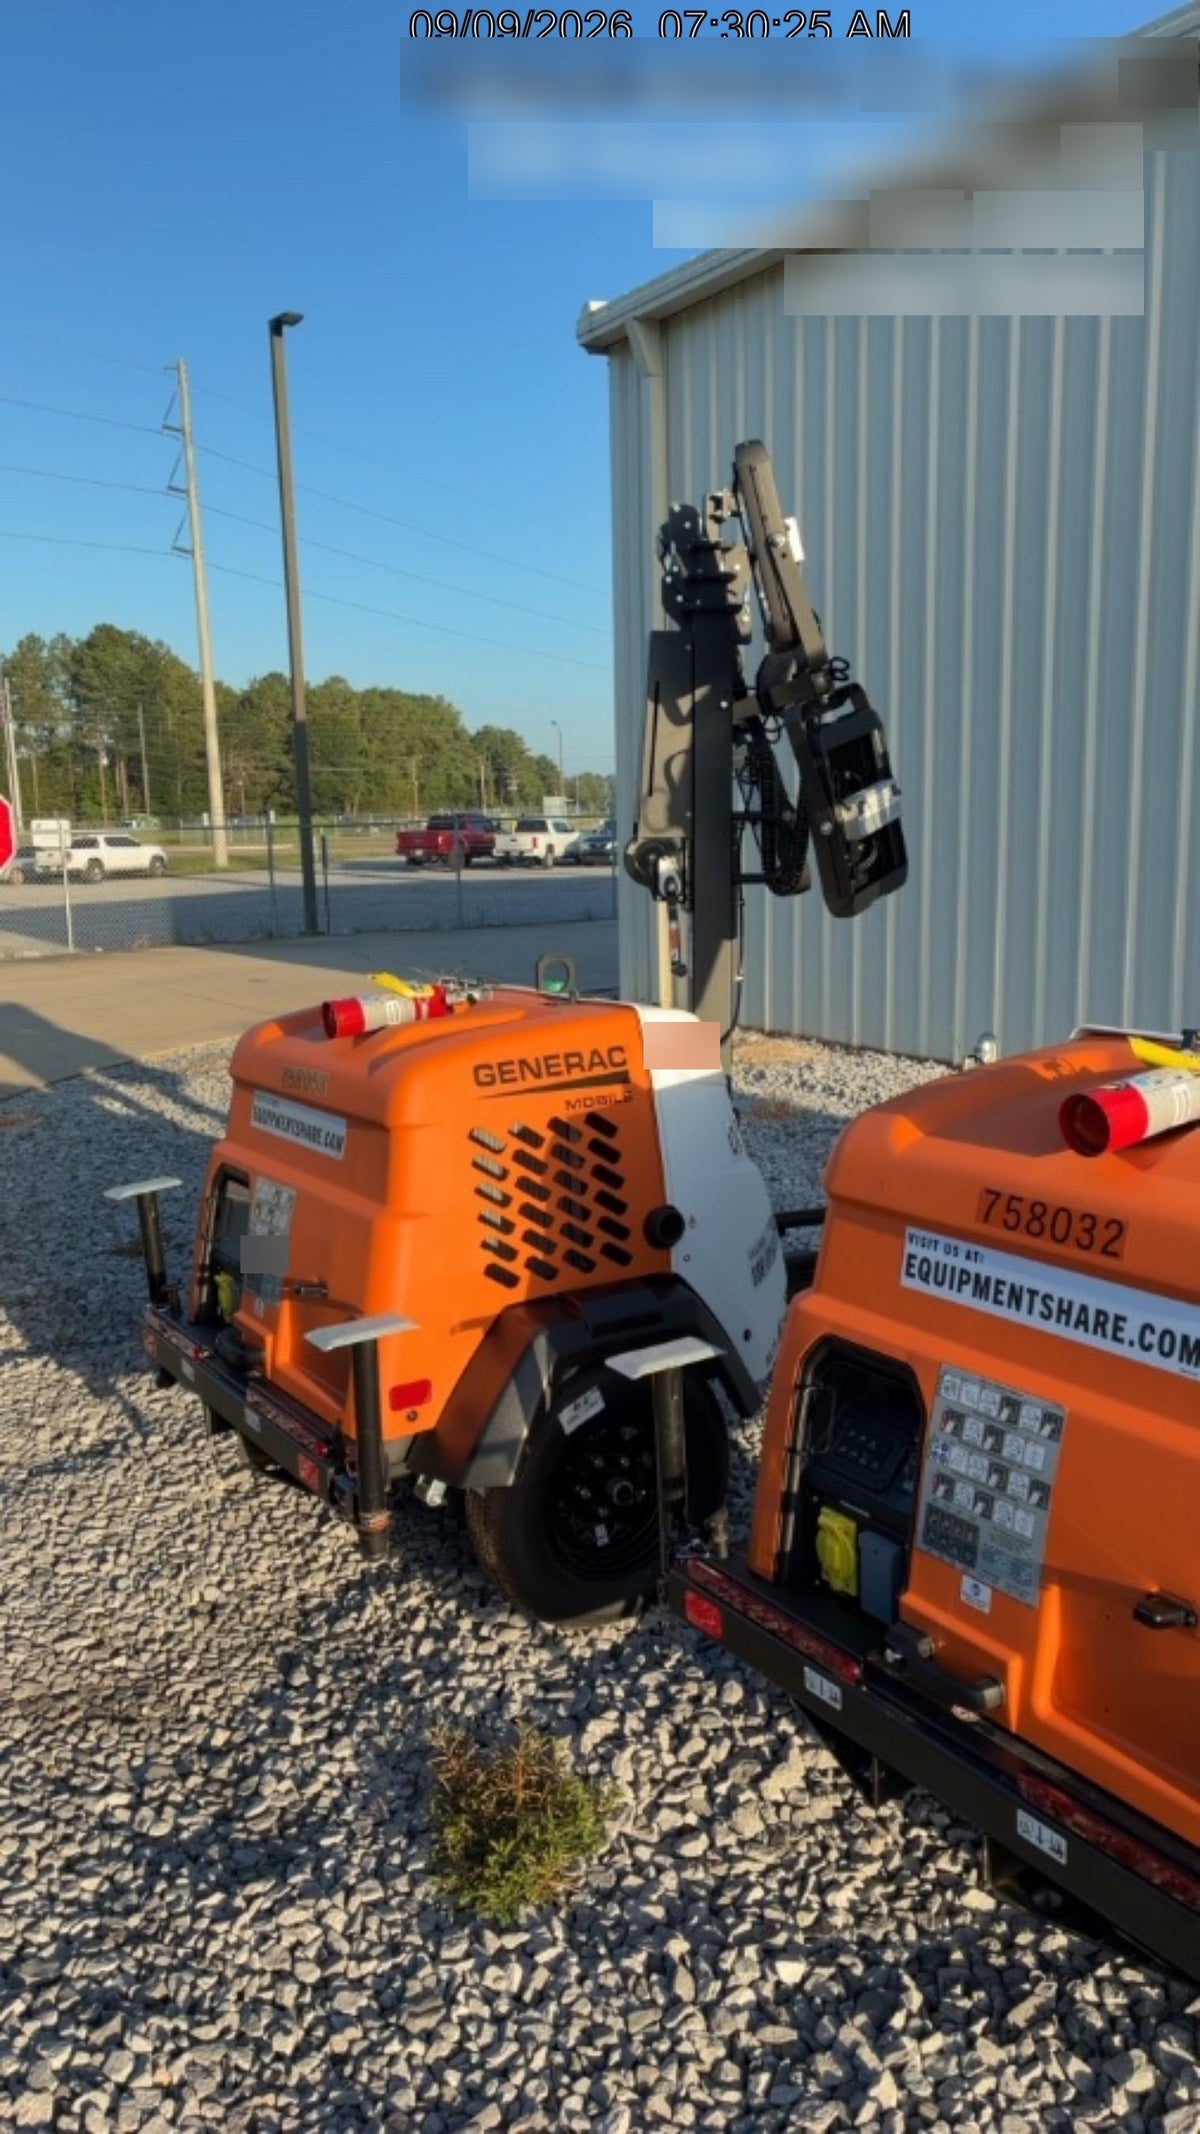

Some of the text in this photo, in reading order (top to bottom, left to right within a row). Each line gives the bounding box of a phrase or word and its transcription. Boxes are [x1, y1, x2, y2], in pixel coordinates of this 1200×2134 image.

[473, 1045, 627, 1087] GENERAC
[564, 1090, 633, 1111] MOBILE
[983, 1188, 1125, 1258] 758032
[908, 1232, 939, 1252] VISIT
[943, 1242, 959, 1257] US
[904, 1253, 1200, 1369] EQUIPMENTSHARE.COM
